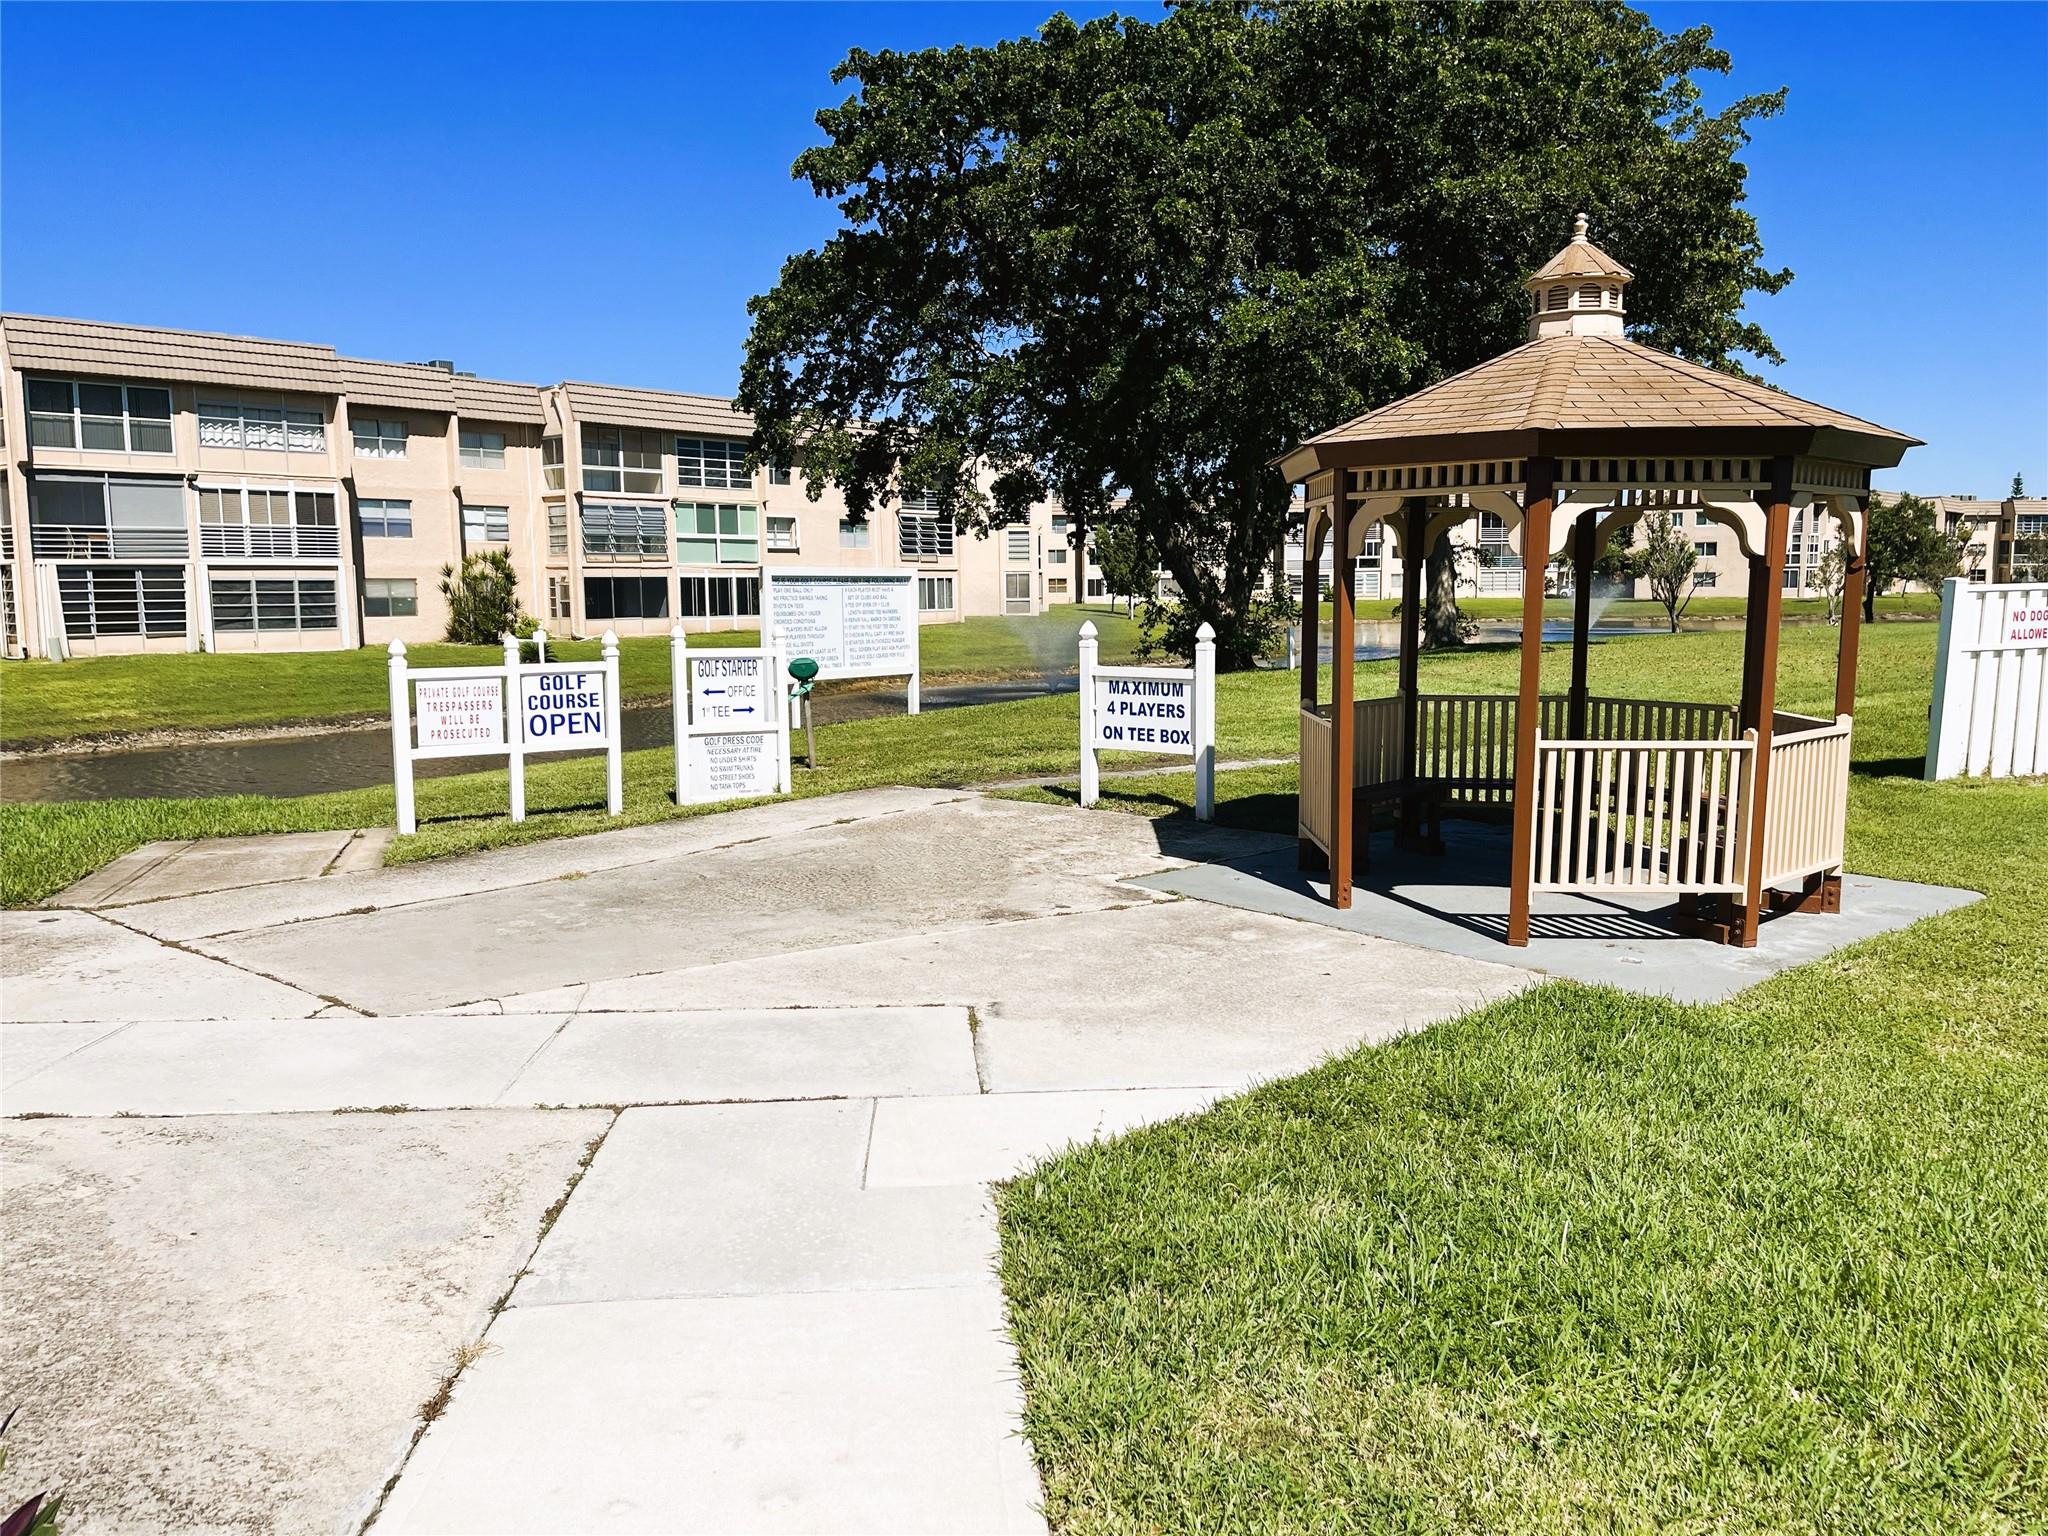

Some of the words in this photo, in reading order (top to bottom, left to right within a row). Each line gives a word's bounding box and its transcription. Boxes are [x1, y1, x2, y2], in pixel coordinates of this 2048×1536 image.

[2013, 610, 2026, 622] NO
[698, 660, 719, 677] GOLF
[722, 660, 758, 677] STARTER
[540, 674, 586, 691] GOLF
[1108, 680, 1184, 697] MAXIMUM
[419, 687, 448, 698] PRIVATE
[453, 687, 469, 697] GOLF
[473, 686, 498, 696] COURSE
[728, 685, 756, 697] OFFICE
[427, 700, 493, 712] TRESPASSERS
[528, 693, 600, 710] COURSE
[712, 706, 730, 717] TEE
[1107, 701, 1115, 715] 4
[1120, 701, 1185, 719] PLAYERS
[441, 715, 464, 725] WILL
[470, 714, 480, 724] BE
[530, 712, 601, 736] OPEN
[431, 728, 490, 739] PROSECUTED
[1103, 726, 1123, 740] ON
[1128, 727, 1155, 742] TEE
[1160, 729, 1190, 744] BOX
[704, 737, 721, 746] GOLF
[722, 736, 745, 745] DRESS
[746, 736, 764, 744] CODE
